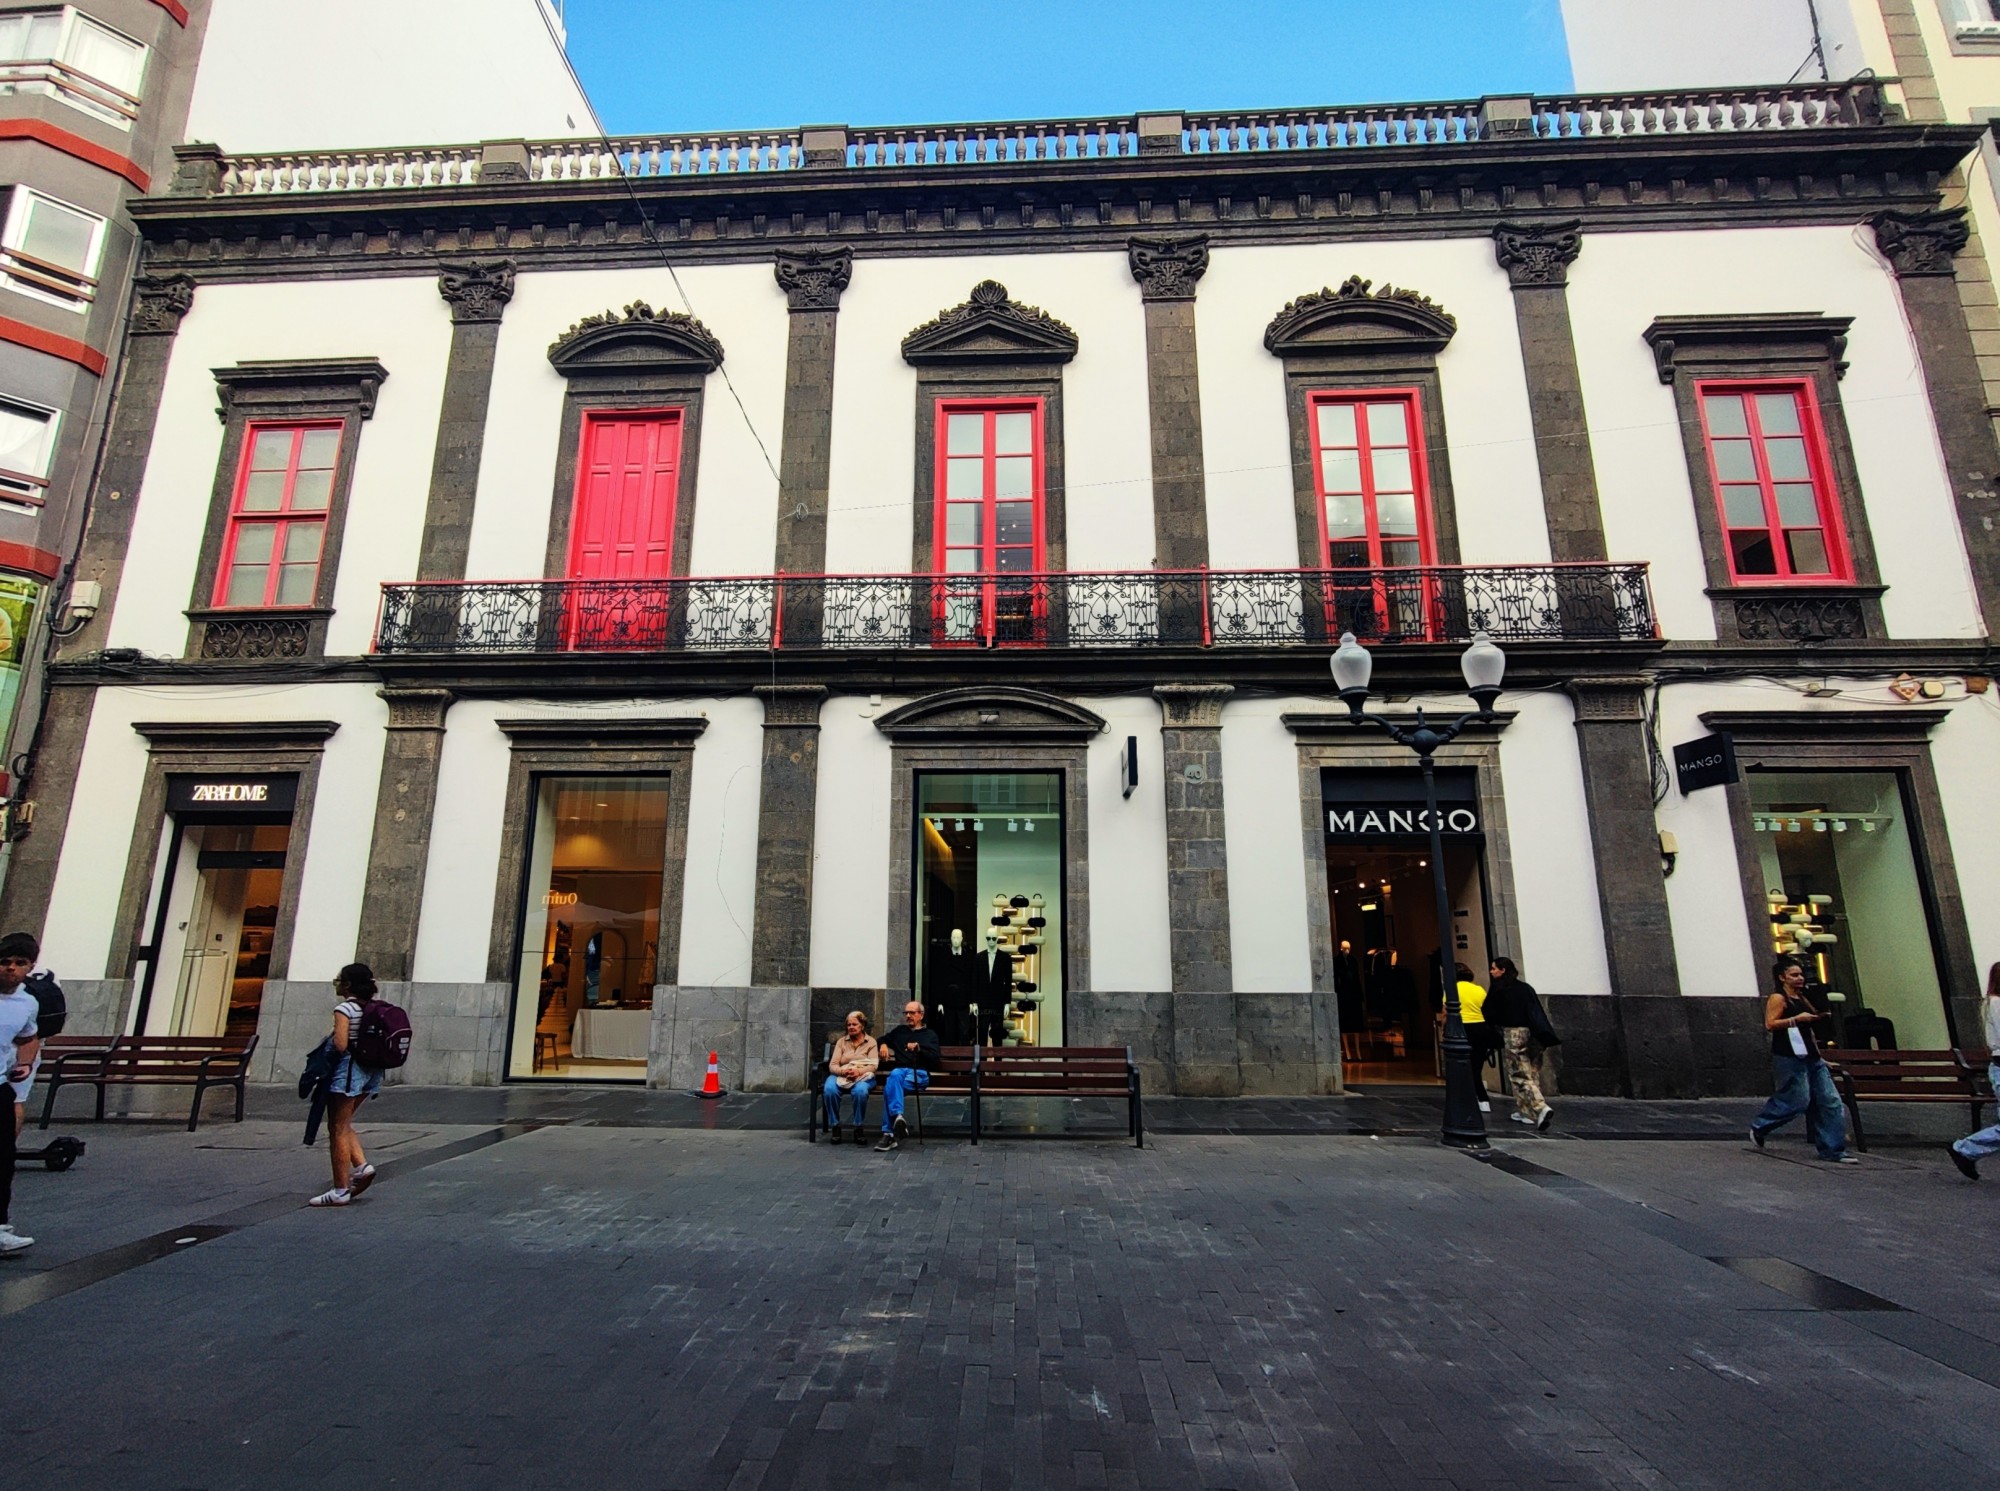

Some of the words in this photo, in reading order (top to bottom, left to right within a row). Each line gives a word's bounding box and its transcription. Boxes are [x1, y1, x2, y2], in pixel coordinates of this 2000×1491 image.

[1680, 754, 1723, 773] MANGO
[1186, 769, 1202, 780] 40
[1329, 809, 1476, 833] MANGO
